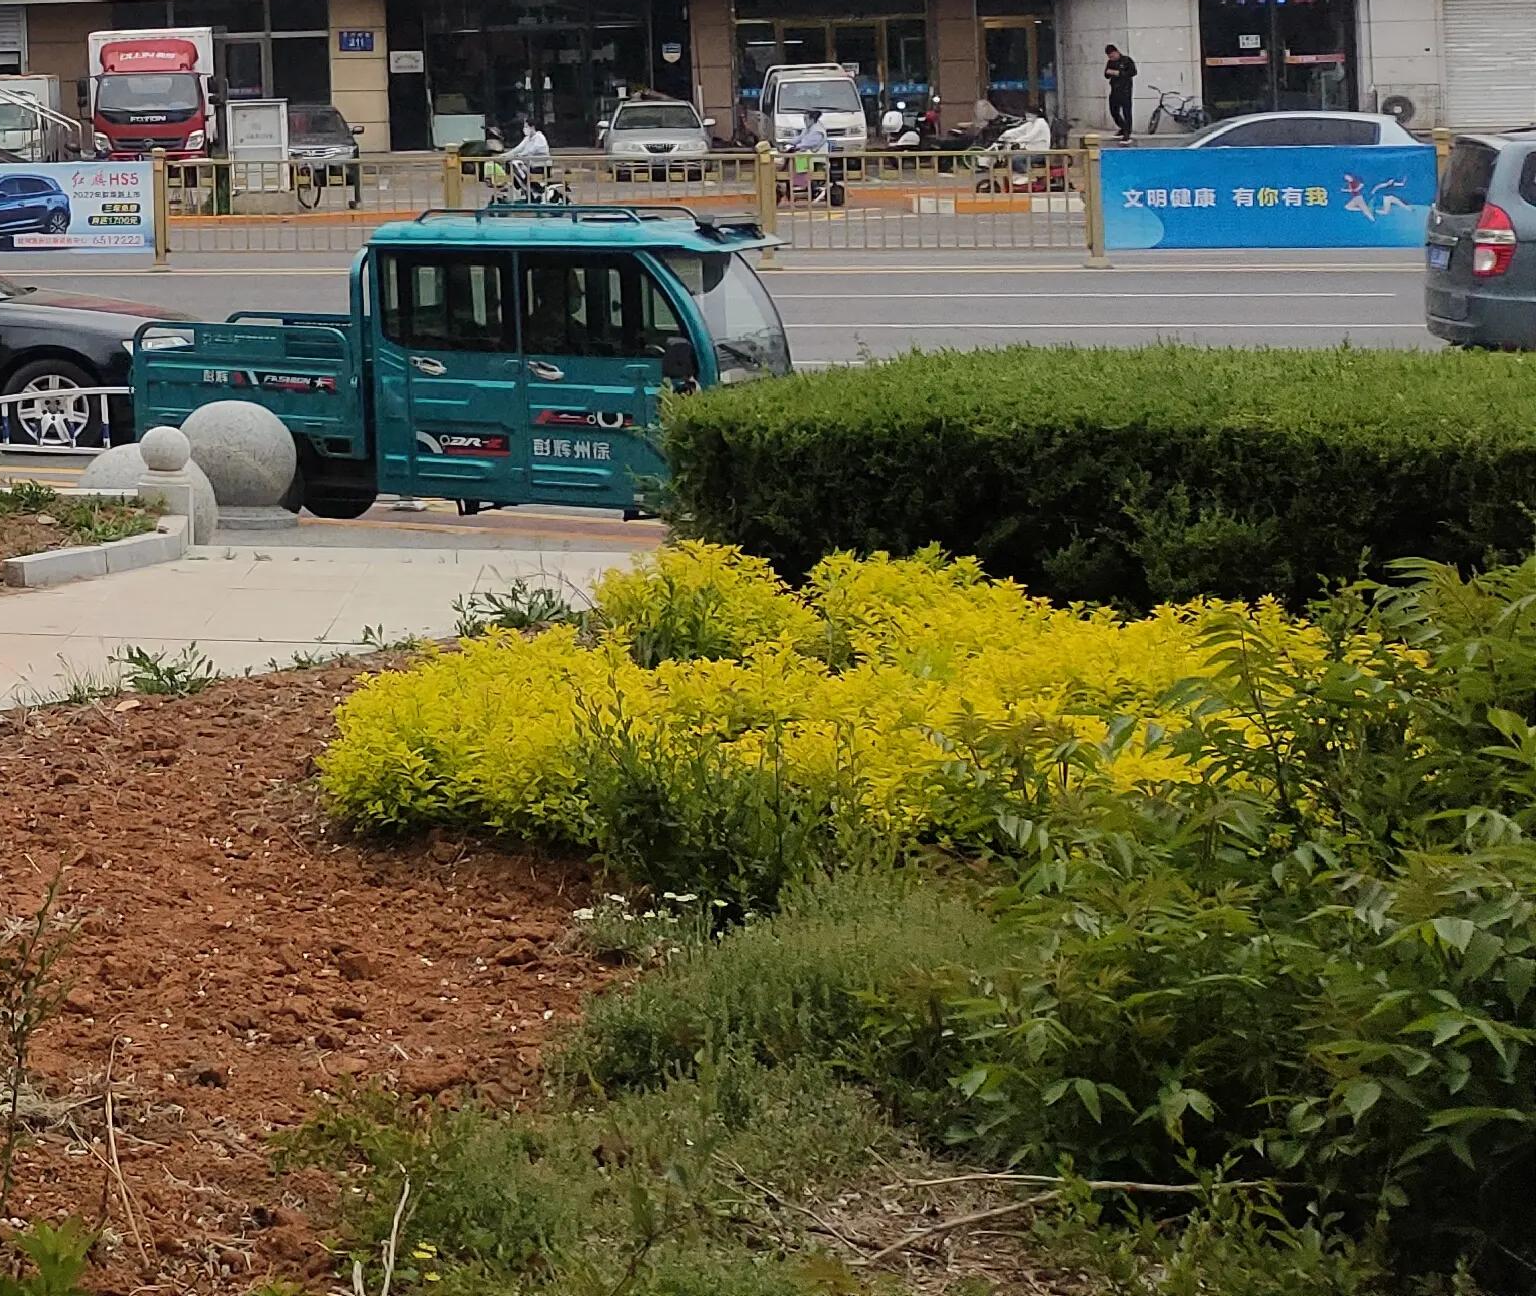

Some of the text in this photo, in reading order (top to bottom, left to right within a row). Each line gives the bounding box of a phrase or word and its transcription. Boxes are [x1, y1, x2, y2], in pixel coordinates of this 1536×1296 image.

[1122, 186, 1329, 209] 文明健康 有你有我
